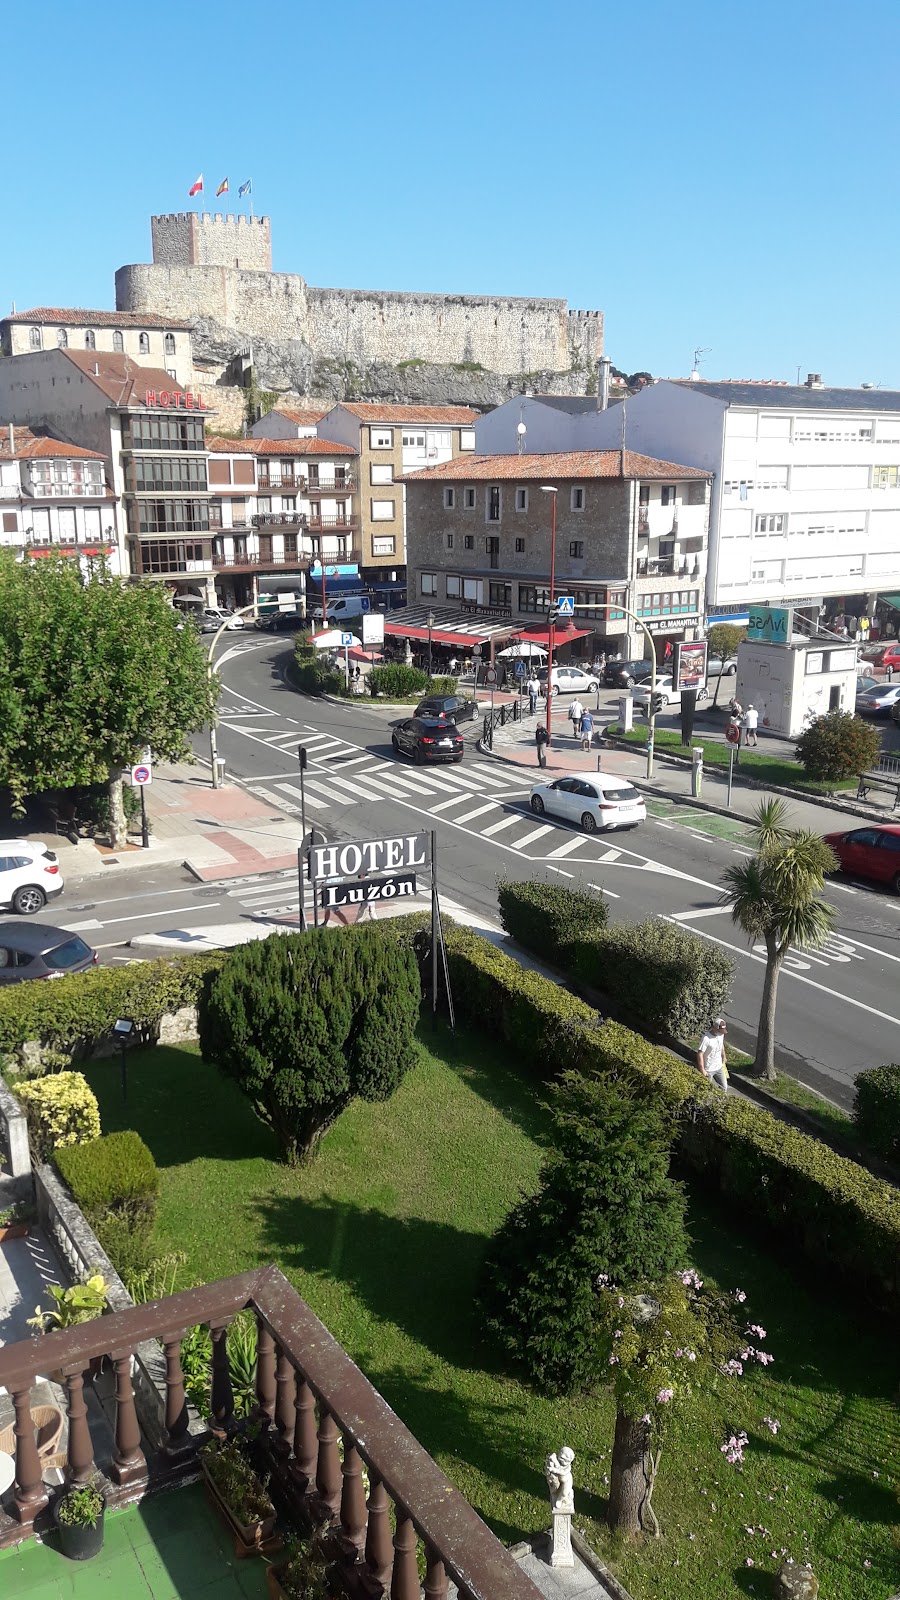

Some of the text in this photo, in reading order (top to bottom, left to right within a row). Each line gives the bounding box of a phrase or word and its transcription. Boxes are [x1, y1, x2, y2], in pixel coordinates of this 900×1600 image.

[145, 389, 207, 410] HOTEL
[668, 618, 698, 628] MANANTIAL
[314, 836, 426, 879] HOTEL
[326, 879, 415, 907] Luzón
